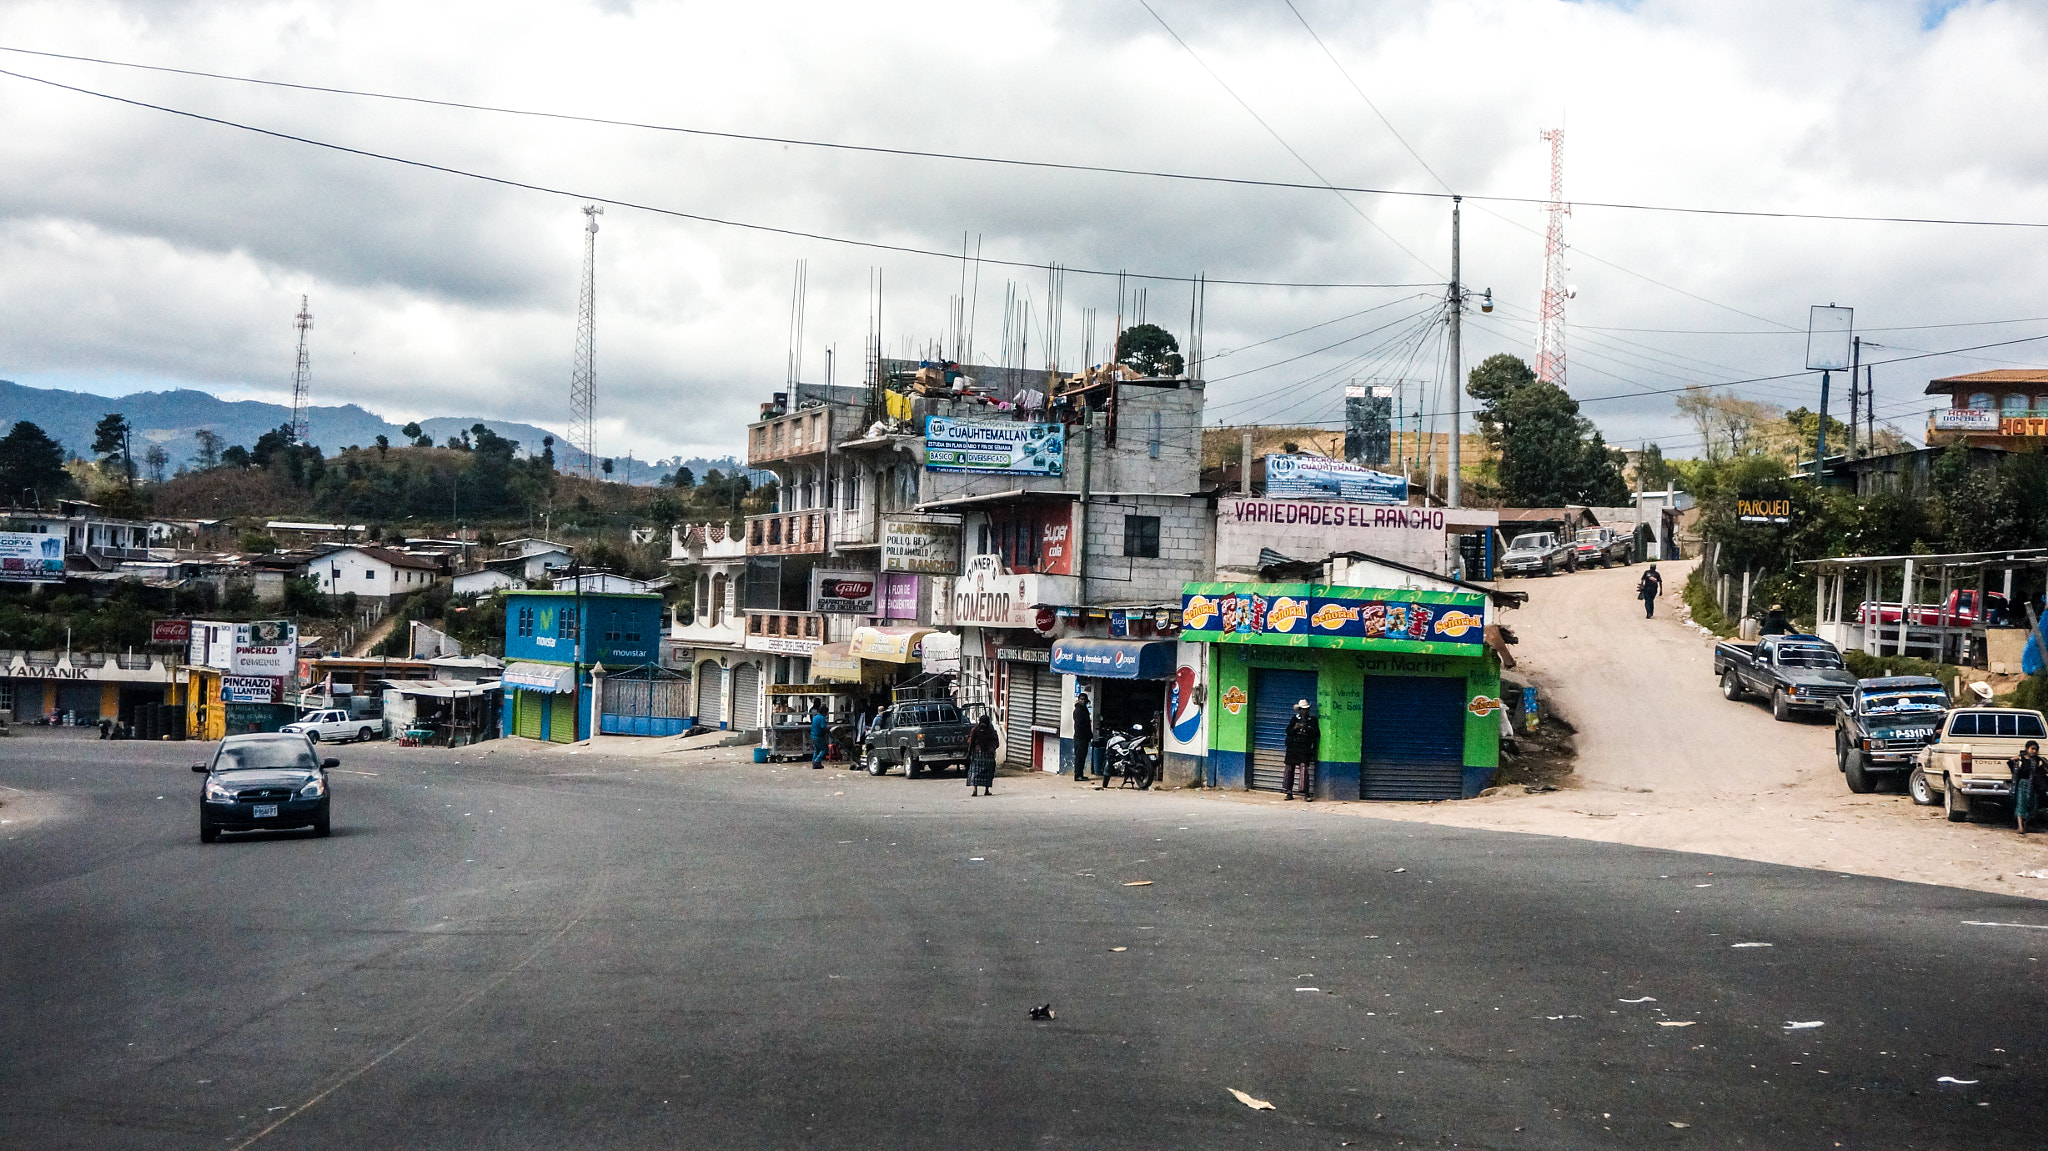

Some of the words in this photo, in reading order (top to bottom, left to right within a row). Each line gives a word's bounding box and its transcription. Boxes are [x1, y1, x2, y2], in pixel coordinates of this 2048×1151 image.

[948, 426, 1028, 441] CUAUHTEMALLAN
[1999, 418, 2048, 436] HOT
[968, 454, 1008, 463] DIVERSIFICADO
[1738, 500, 1790, 517] PARQUEO
[1235, 502, 1345, 526] VARIEDADES
[1348, 507, 1370, 527] EL
[1374, 509, 1444, 531] RANCHO
[1043, 523, 1068, 543] Super
[886, 536, 911, 546] POLLO
[913, 536, 927, 546] REY
[886, 547, 903, 555] POLLO
[1048, 545, 1062, 557] cola
[888, 558, 904, 569] EL
[908, 559, 957, 573] RANCHO
[966, 556, 998, 582] DINNER'S
[835, 582, 868, 595] Gallo
[955, 592, 1010, 623] COMEDOR
[1182, 599, 1219, 627] Señorial
[1267, 600, 1308, 629] Señorial
[1112, 617, 1126, 629] tigo
[1311, 607, 1360, 628] Señorial
[1434, 615, 1483, 635] Señorial
[236, 646, 278, 654] PINCHAZO
[612, 648, 647, 658] movistar
[1061, 653, 1074, 661] pepsi
[1123, 656, 1136, 665] pepsi
[1355, 654, 1387, 670] San
[4, 665, 89, 679] YAMANIK
[223, 677, 271, 688] PINCHAZO
[233, 687, 271, 696] LLANTERA
